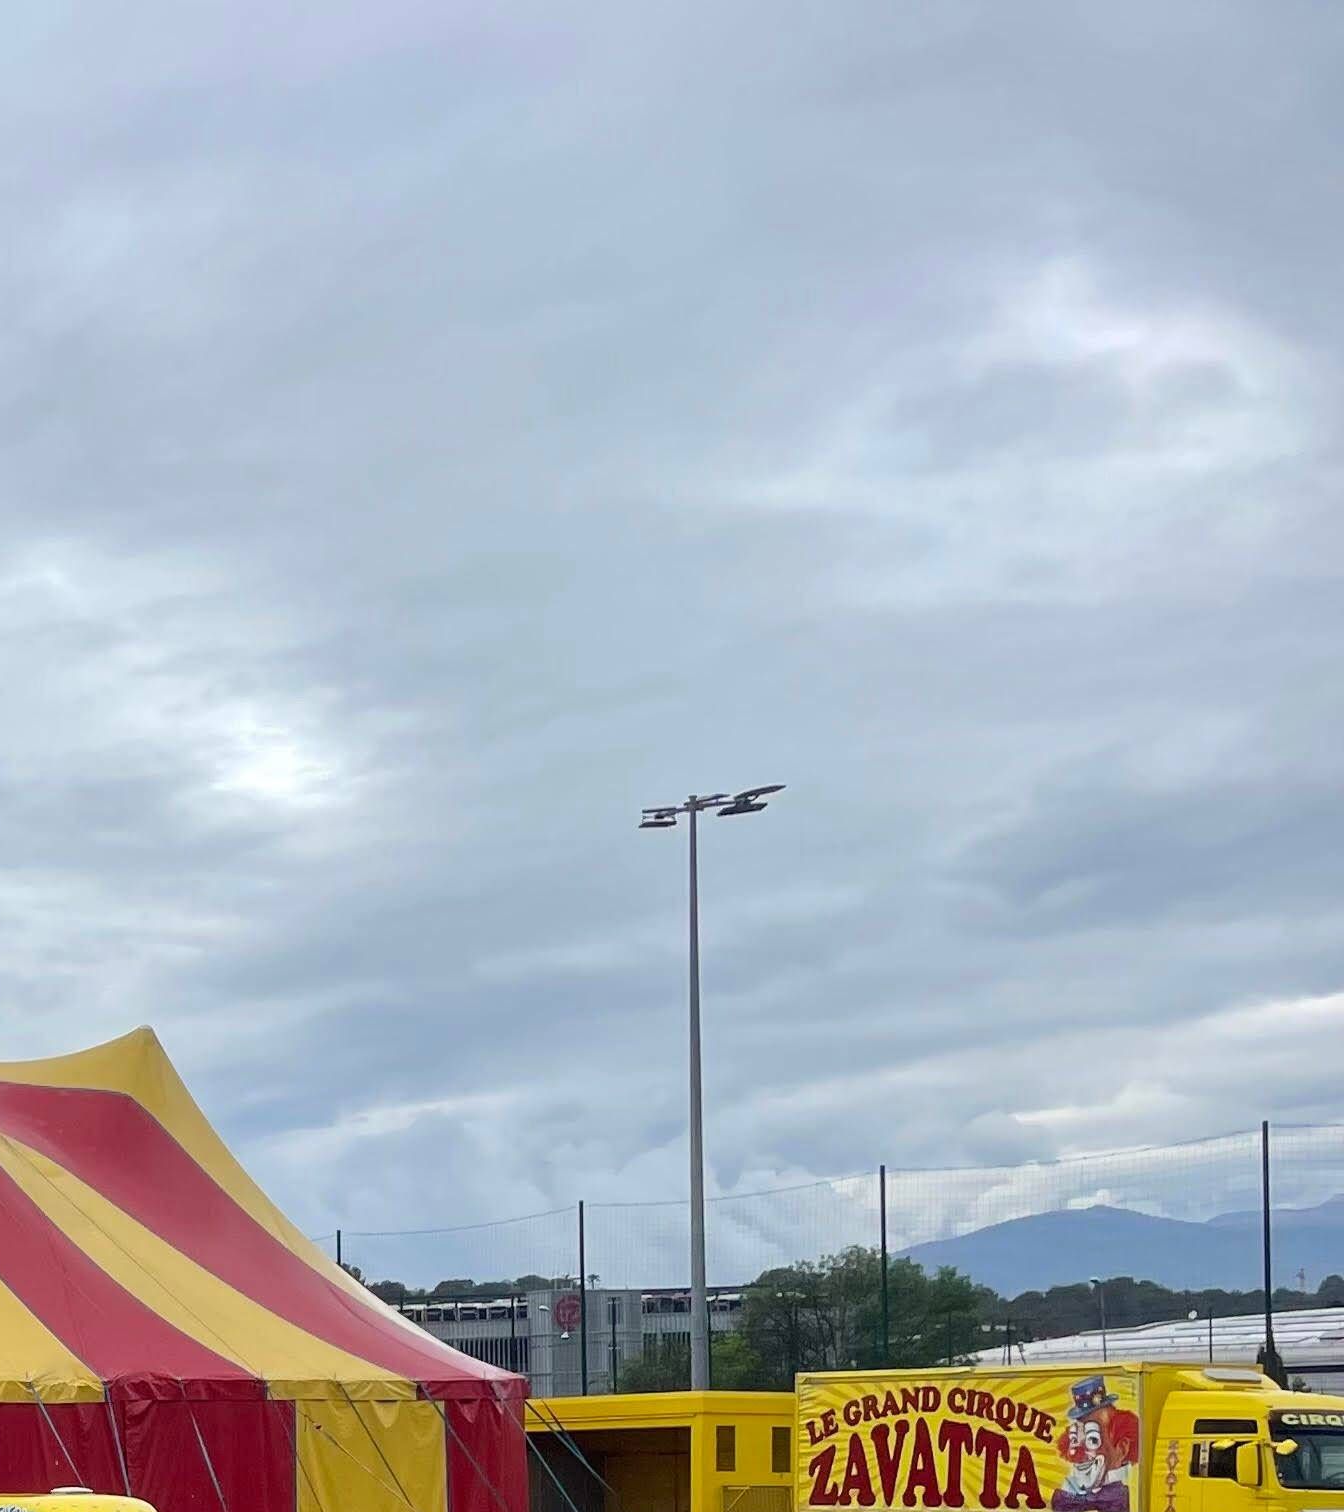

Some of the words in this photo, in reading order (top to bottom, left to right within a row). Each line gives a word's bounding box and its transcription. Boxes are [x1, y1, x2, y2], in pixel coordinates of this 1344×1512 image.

[806, 1408, 840, 1447] LE
[843, 1386, 942, 1427] GRAND
[947, 1386, 1058, 1444] CIRQUE
[1280, 1413, 1344, 1427] CIRQ
[808, 1416, 1048, 1510] ZAVATTA
